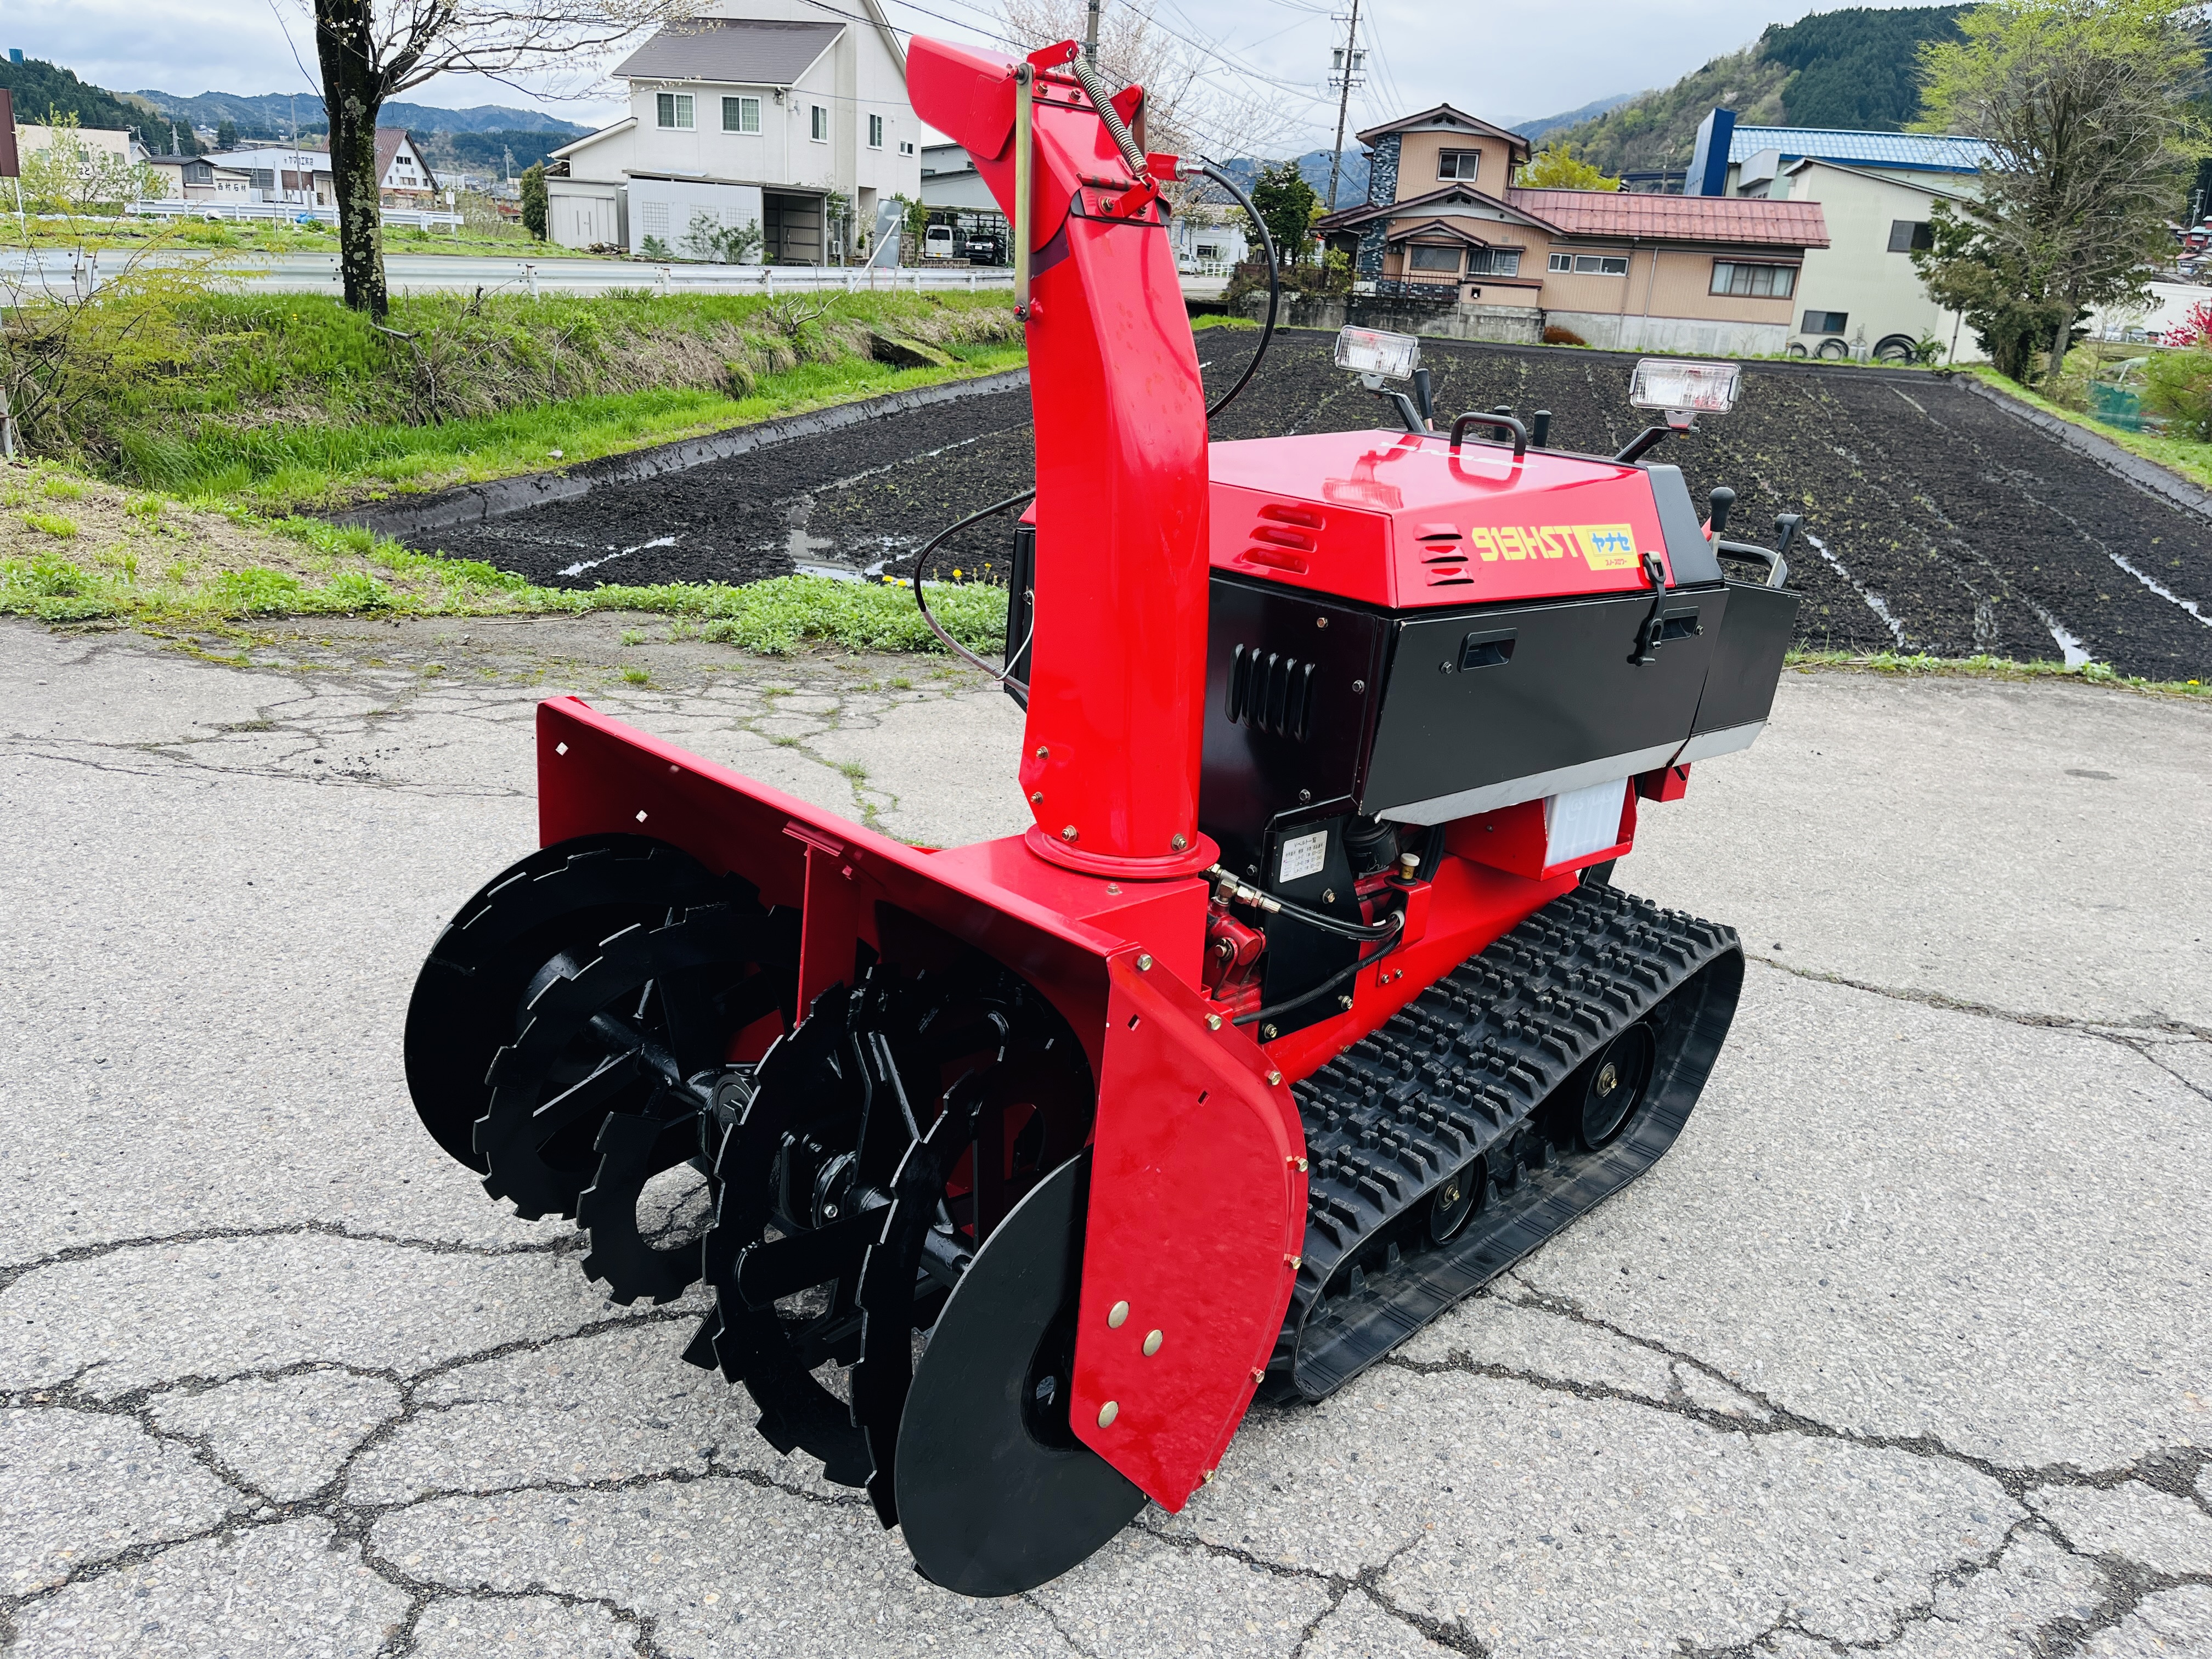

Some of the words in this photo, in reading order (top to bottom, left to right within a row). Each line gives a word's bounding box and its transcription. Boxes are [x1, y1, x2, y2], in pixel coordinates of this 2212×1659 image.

[218, 183, 246, 192] 西村石材
[1472, 526, 1578, 561] 913HST
[1592, 532, 1630, 553] ヤナセ
